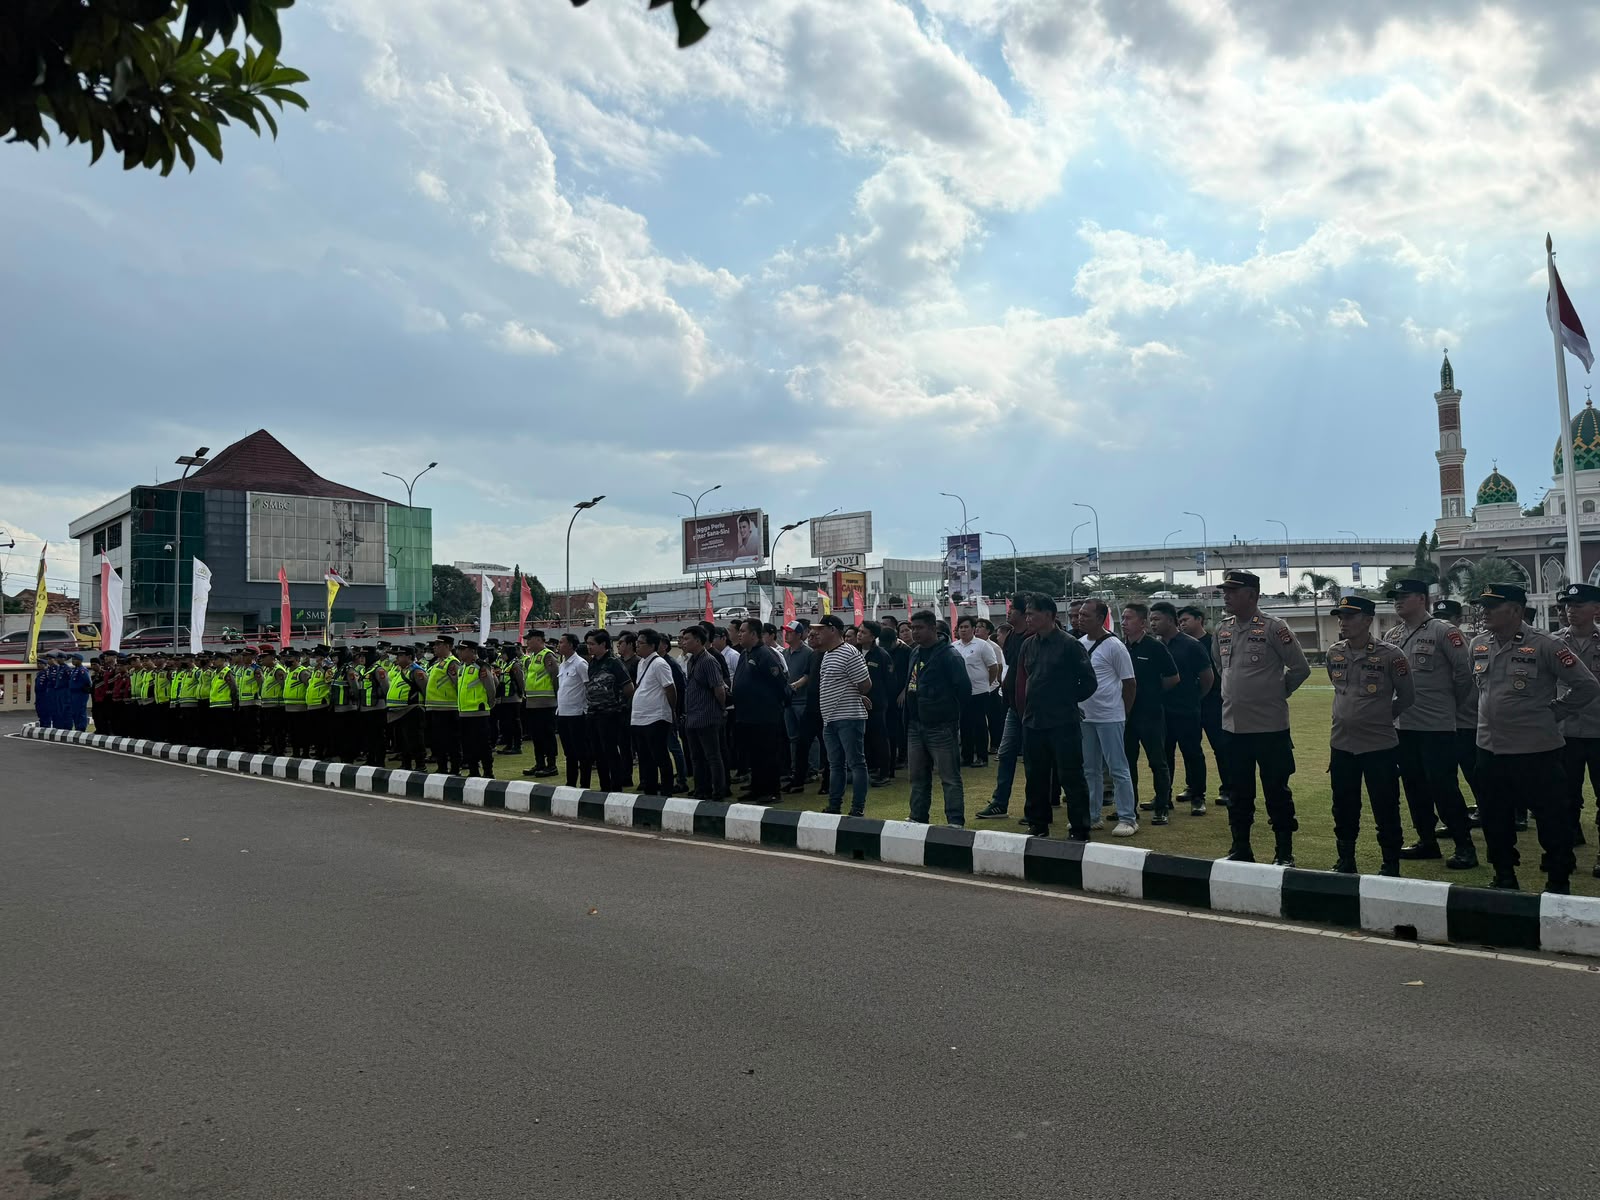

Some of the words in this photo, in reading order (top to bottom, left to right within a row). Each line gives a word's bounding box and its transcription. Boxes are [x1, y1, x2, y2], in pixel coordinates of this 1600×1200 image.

[262, 500, 290, 511] SMBC
[306, 611, 331, 620] SMB
[1361, 663, 1385, 671] POLRI
